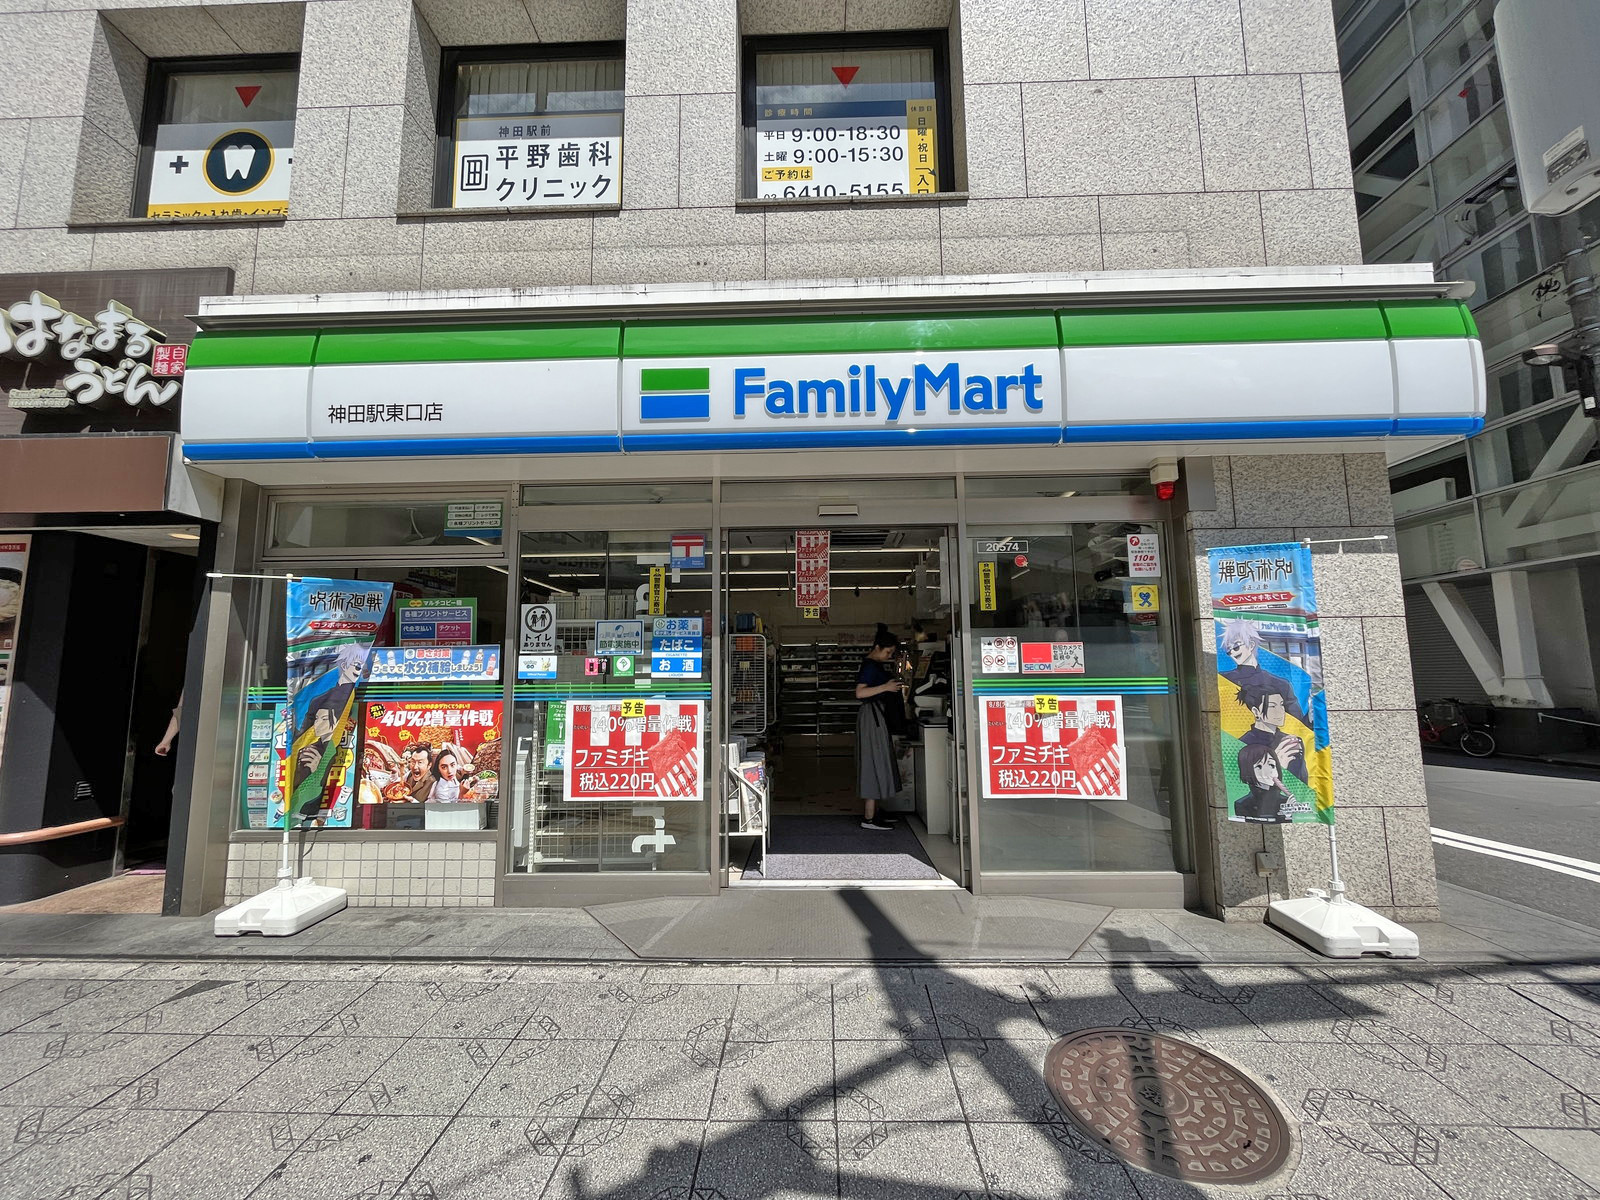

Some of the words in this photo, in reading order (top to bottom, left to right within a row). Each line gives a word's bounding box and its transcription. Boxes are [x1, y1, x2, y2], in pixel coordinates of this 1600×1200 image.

[764, 107, 813, 117] 診療時間
[498, 124, 552, 138] 神田駅前
[763, 130, 785, 141] 平日
[791, 125, 901, 142] 9:00-18:30
[917, 117, 928, 163] 日曜・祝日
[495, 140, 613, 170] 平野歯科
[763, 151, 788, 162] 土曜
[793, 146, 904, 163] 9:00-15:30
[763, 168, 812, 180] ご予約は
[495, 174, 612, 202] クリニック
[783, 182, 904, 198] 6410-5155
[0, 290, 153, 360] はなまる
[154, 347, 171, 375] 製麺
[169, 346, 188, 375] 自家
[63, 357, 182, 406] うどん
[732, 361, 1044, 425] FamilyMart
[327, 401, 444, 424] 神田駅東口店
[985, 542, 1020, 552] 20574
[1134, 554, 1155, 562] 110番
[308, 590, 384, 614] 呪術廻戦
[404, 609, 468, 618] 各種プリントサービス
[805, 607, 819, 617] 予告
[313, 621, 375, 630] コラボキャンペーン
[438, 624, 461, 632] チケット
[666, 619, 689, 631] お薬
[525, 633, 552, 641] トイレ
[599, 639, 640, 649] 節電実施中
[659, 639, 695, 651] たばこ
[416, 648, 452, 659] 暑さ対策
[658, 659, 695, 672] お酒
[1024, 663, 1052, 671] SECOM
[622, 701, 645, 715] 予告
[1036, 697, 1058, 711] 予告
[380, 709, 494, 727] 40%増量作戦
[575, 748, 650, 767] ファミチキ
[992, 744, 1070, 764] ファミチキ
[579, 772, 655, 791] 税込220円
[998, 768, 1077, 788] 税込220円
